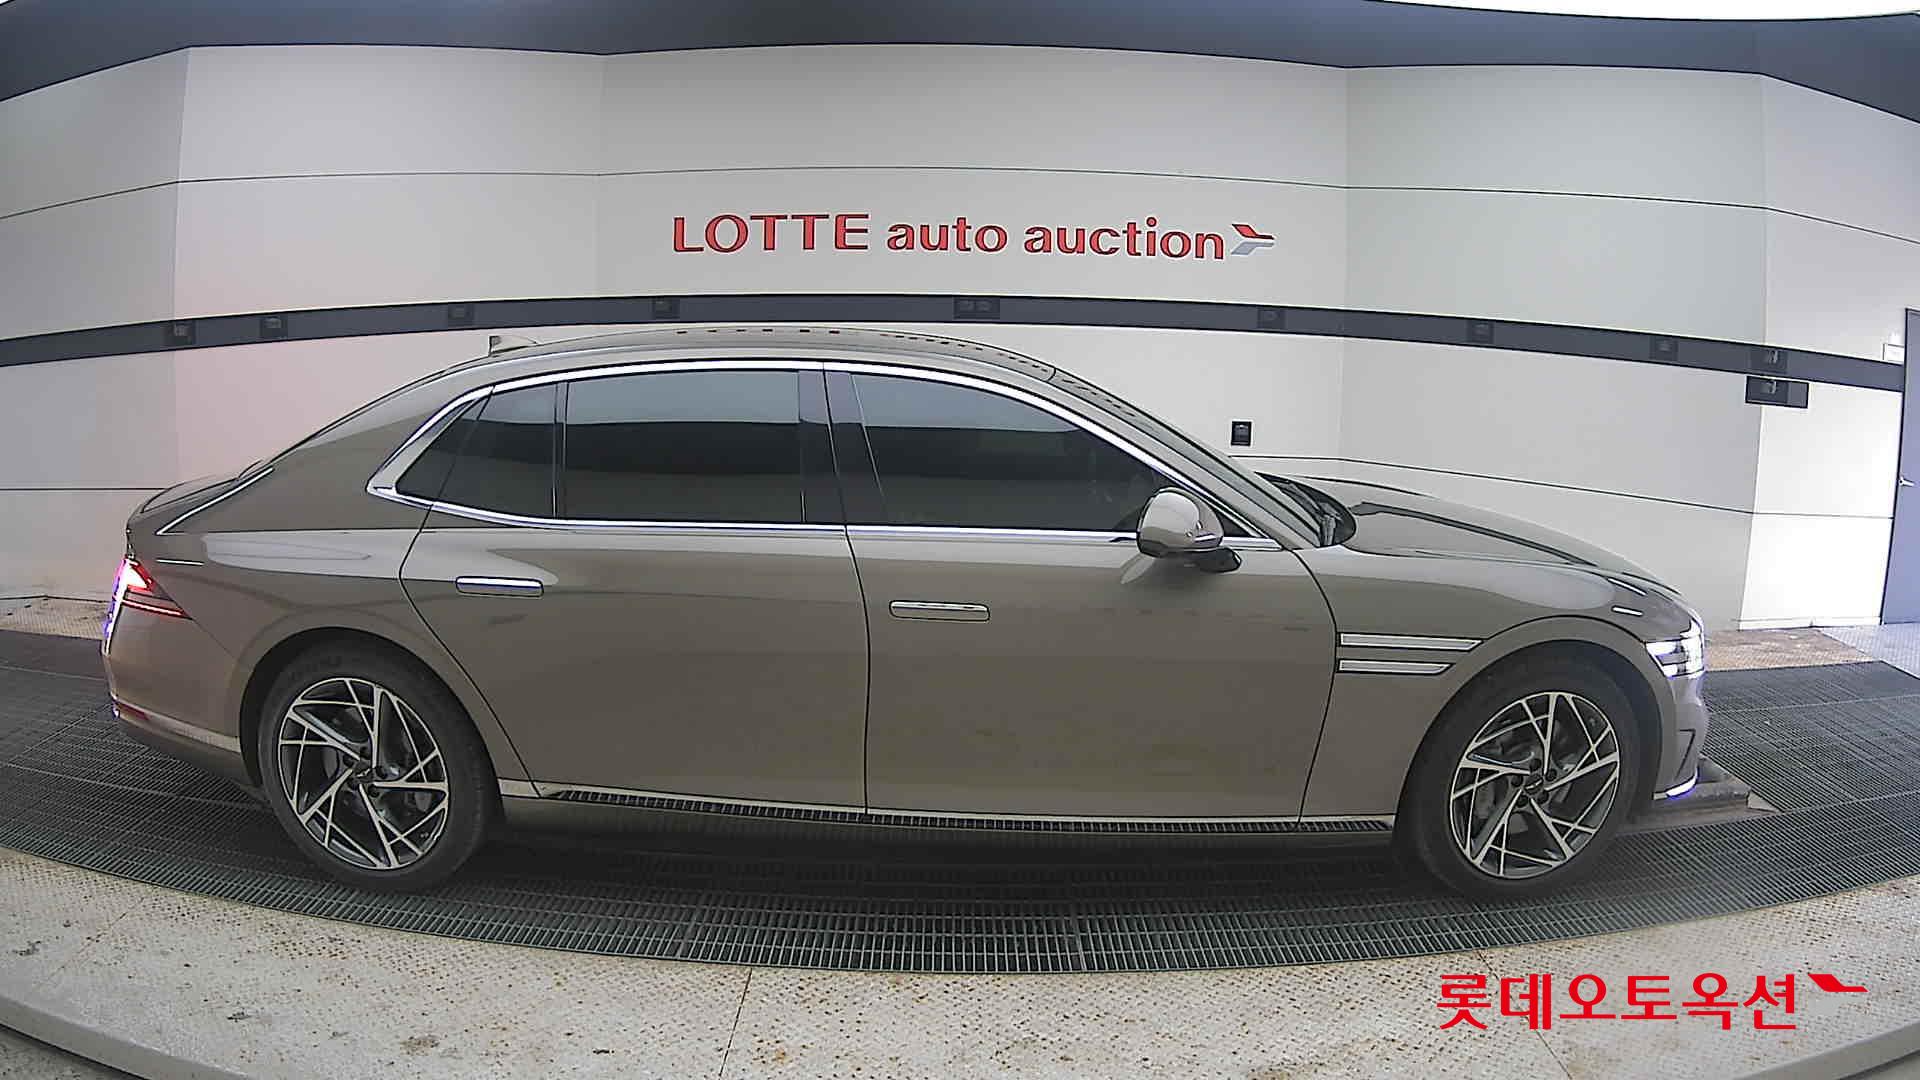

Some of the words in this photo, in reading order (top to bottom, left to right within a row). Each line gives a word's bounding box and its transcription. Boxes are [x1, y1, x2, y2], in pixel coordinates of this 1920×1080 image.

[673, 214, 869, 253] LOTTE
[886, 216, 1008, 253] auto
[1022, 217, 1225, 260] auction
